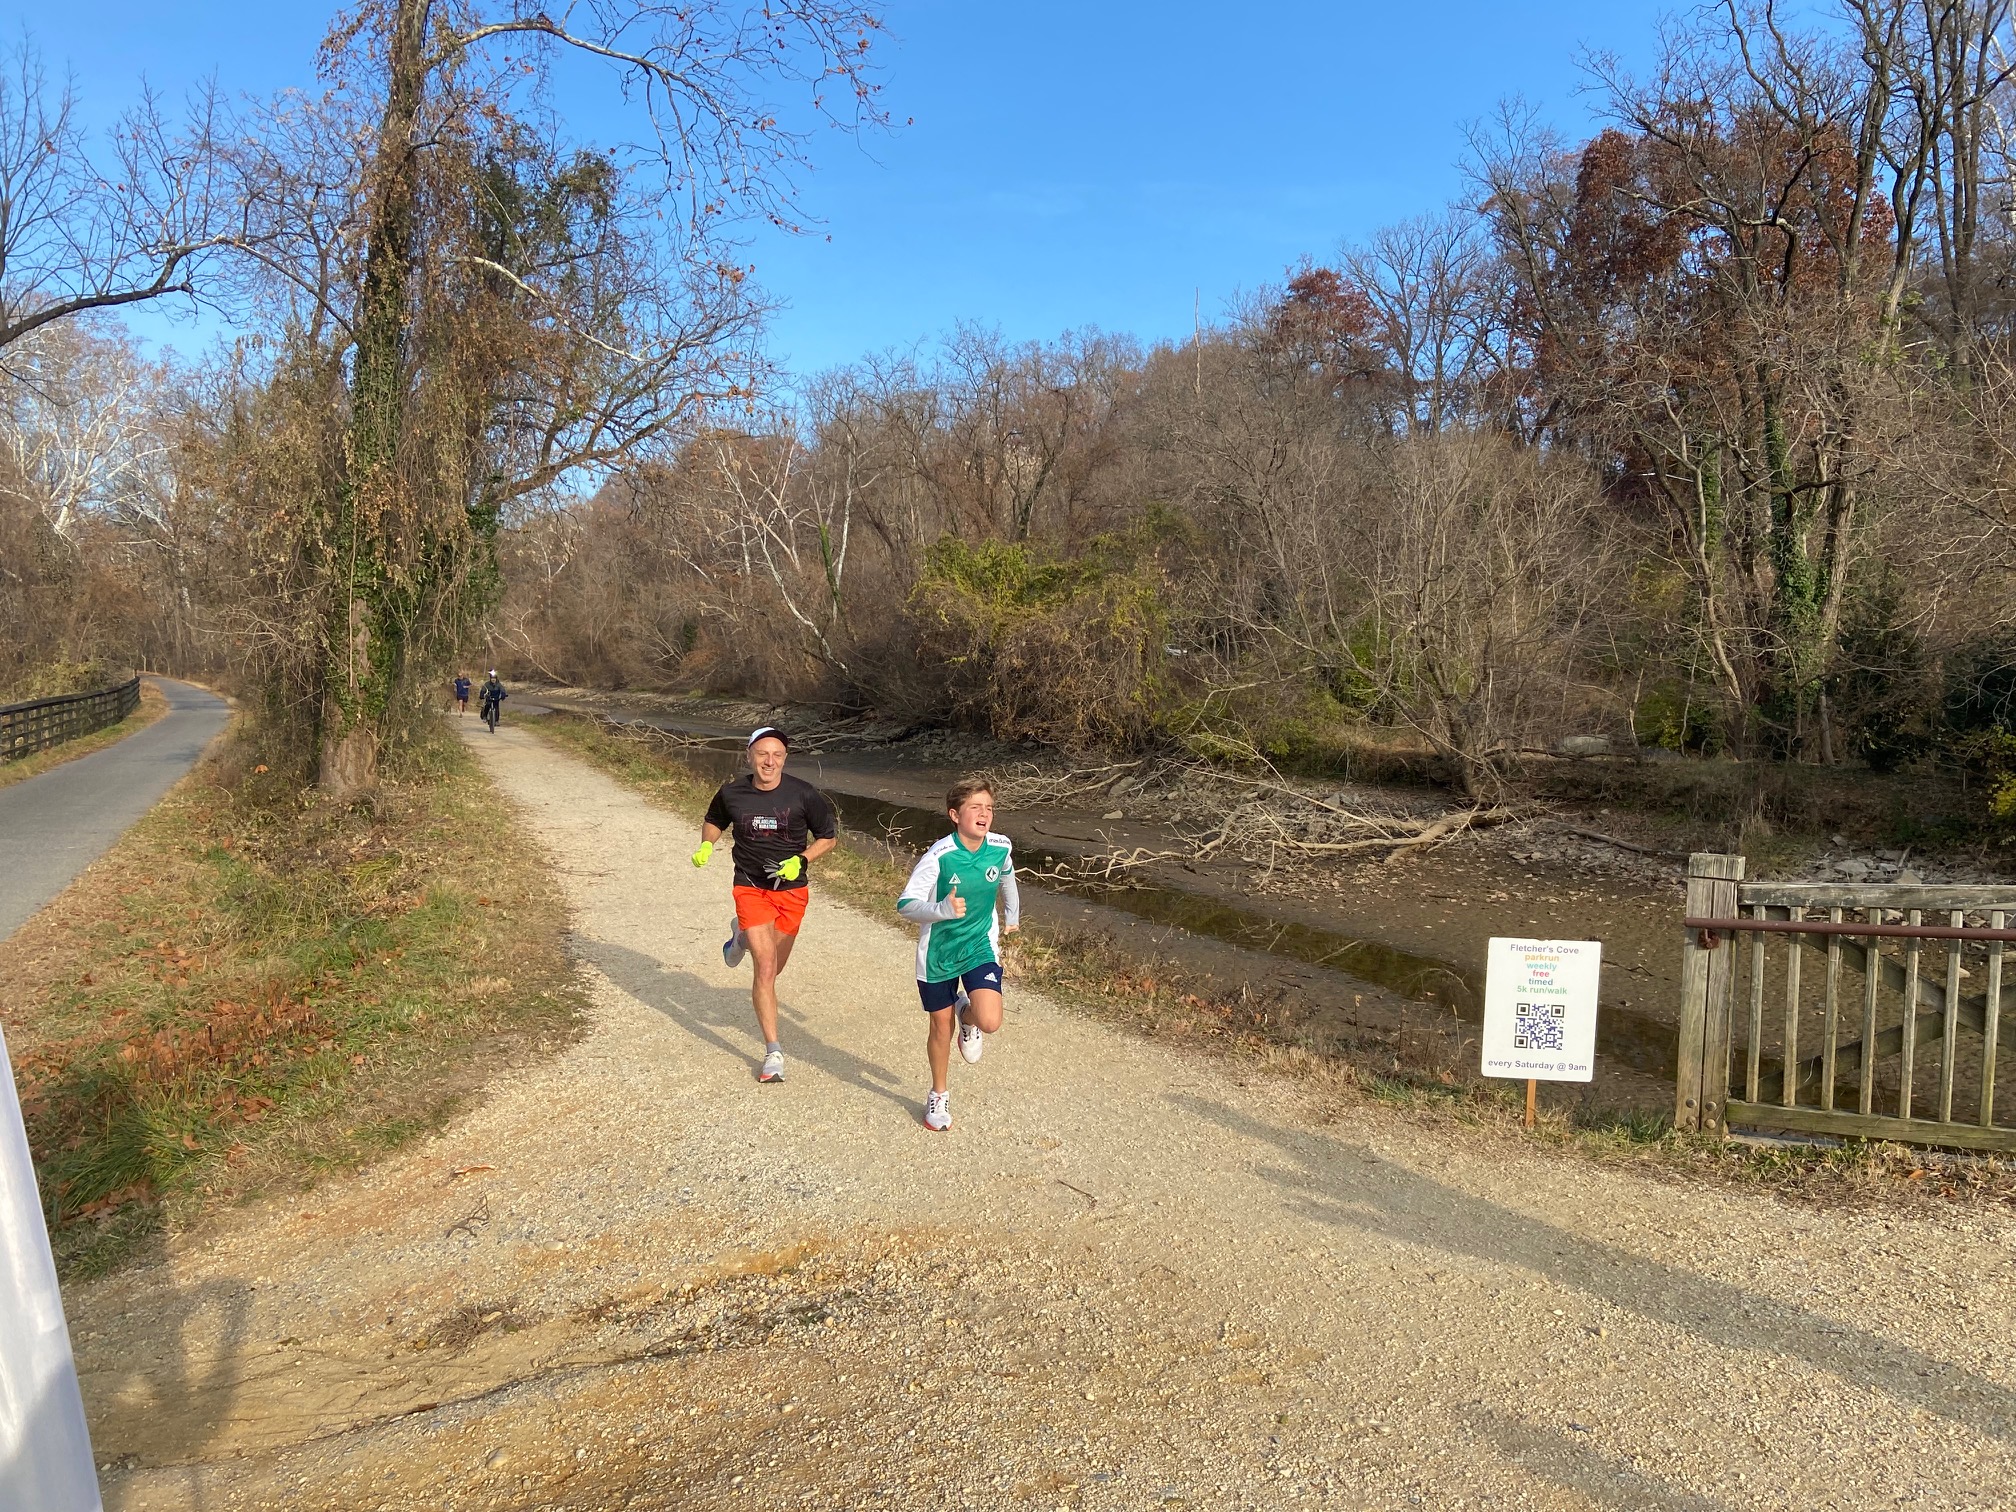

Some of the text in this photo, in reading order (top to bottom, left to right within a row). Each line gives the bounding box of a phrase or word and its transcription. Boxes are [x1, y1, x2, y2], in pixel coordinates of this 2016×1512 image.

[1510, 944, 1579, 954] Fletcher's Cove
[1524, 953, 1560, 962] parkrun
[1527, 962, 1557, 971] weekly
[1530, 987, 1567, 995] run/walk
[1488, 1060, 1587, 1071] every Saturday @ 9am
